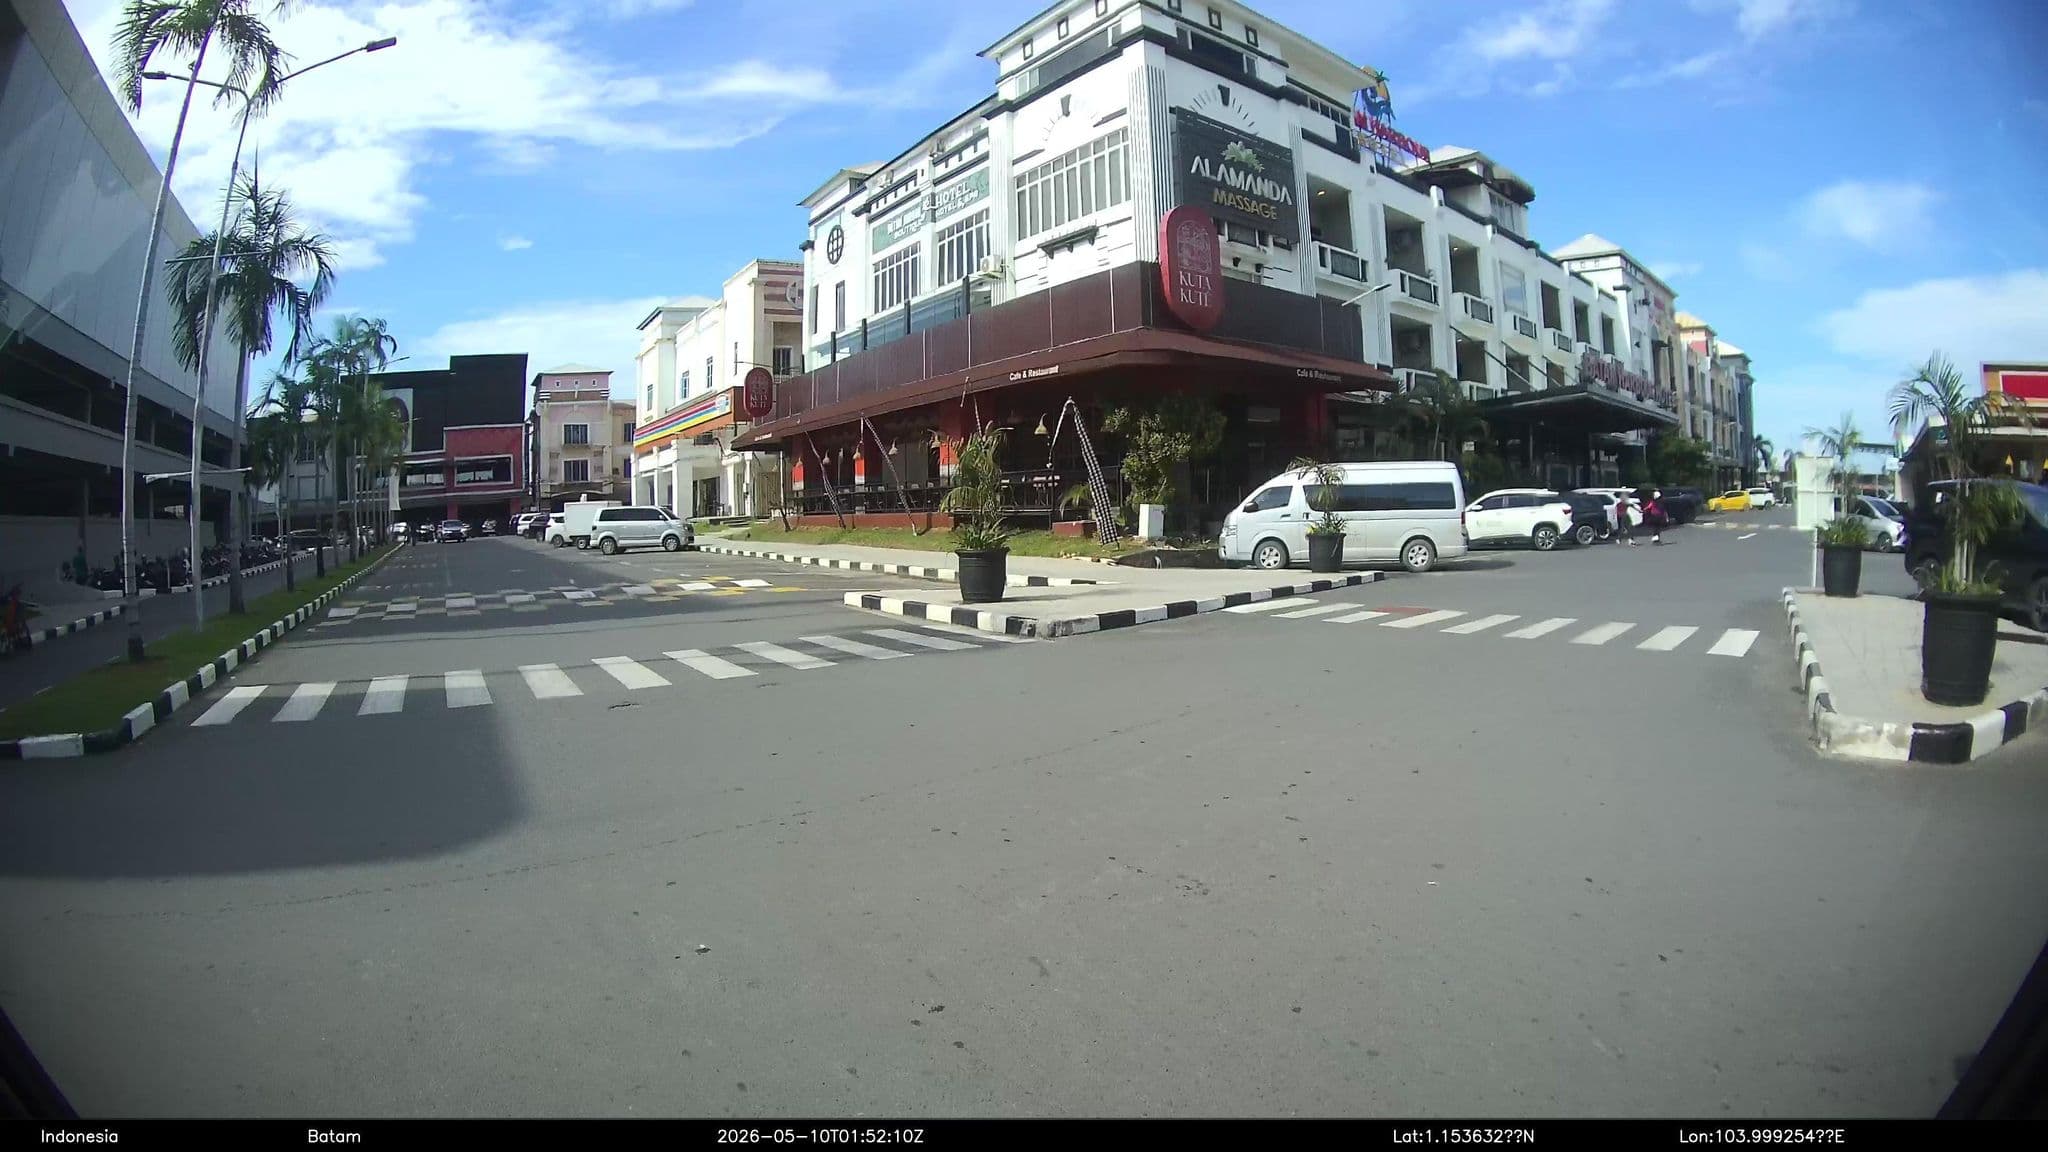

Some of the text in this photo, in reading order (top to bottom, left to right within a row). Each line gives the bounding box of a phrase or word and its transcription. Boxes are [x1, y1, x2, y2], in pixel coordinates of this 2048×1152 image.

[1191, 155, 1292, 205] ALAMANDA
[935, 182, 970, 207] HOTEL
[1213, 188, 1278, 220] MASSAGE
[1179, 271, 1212, 290] KUTA
